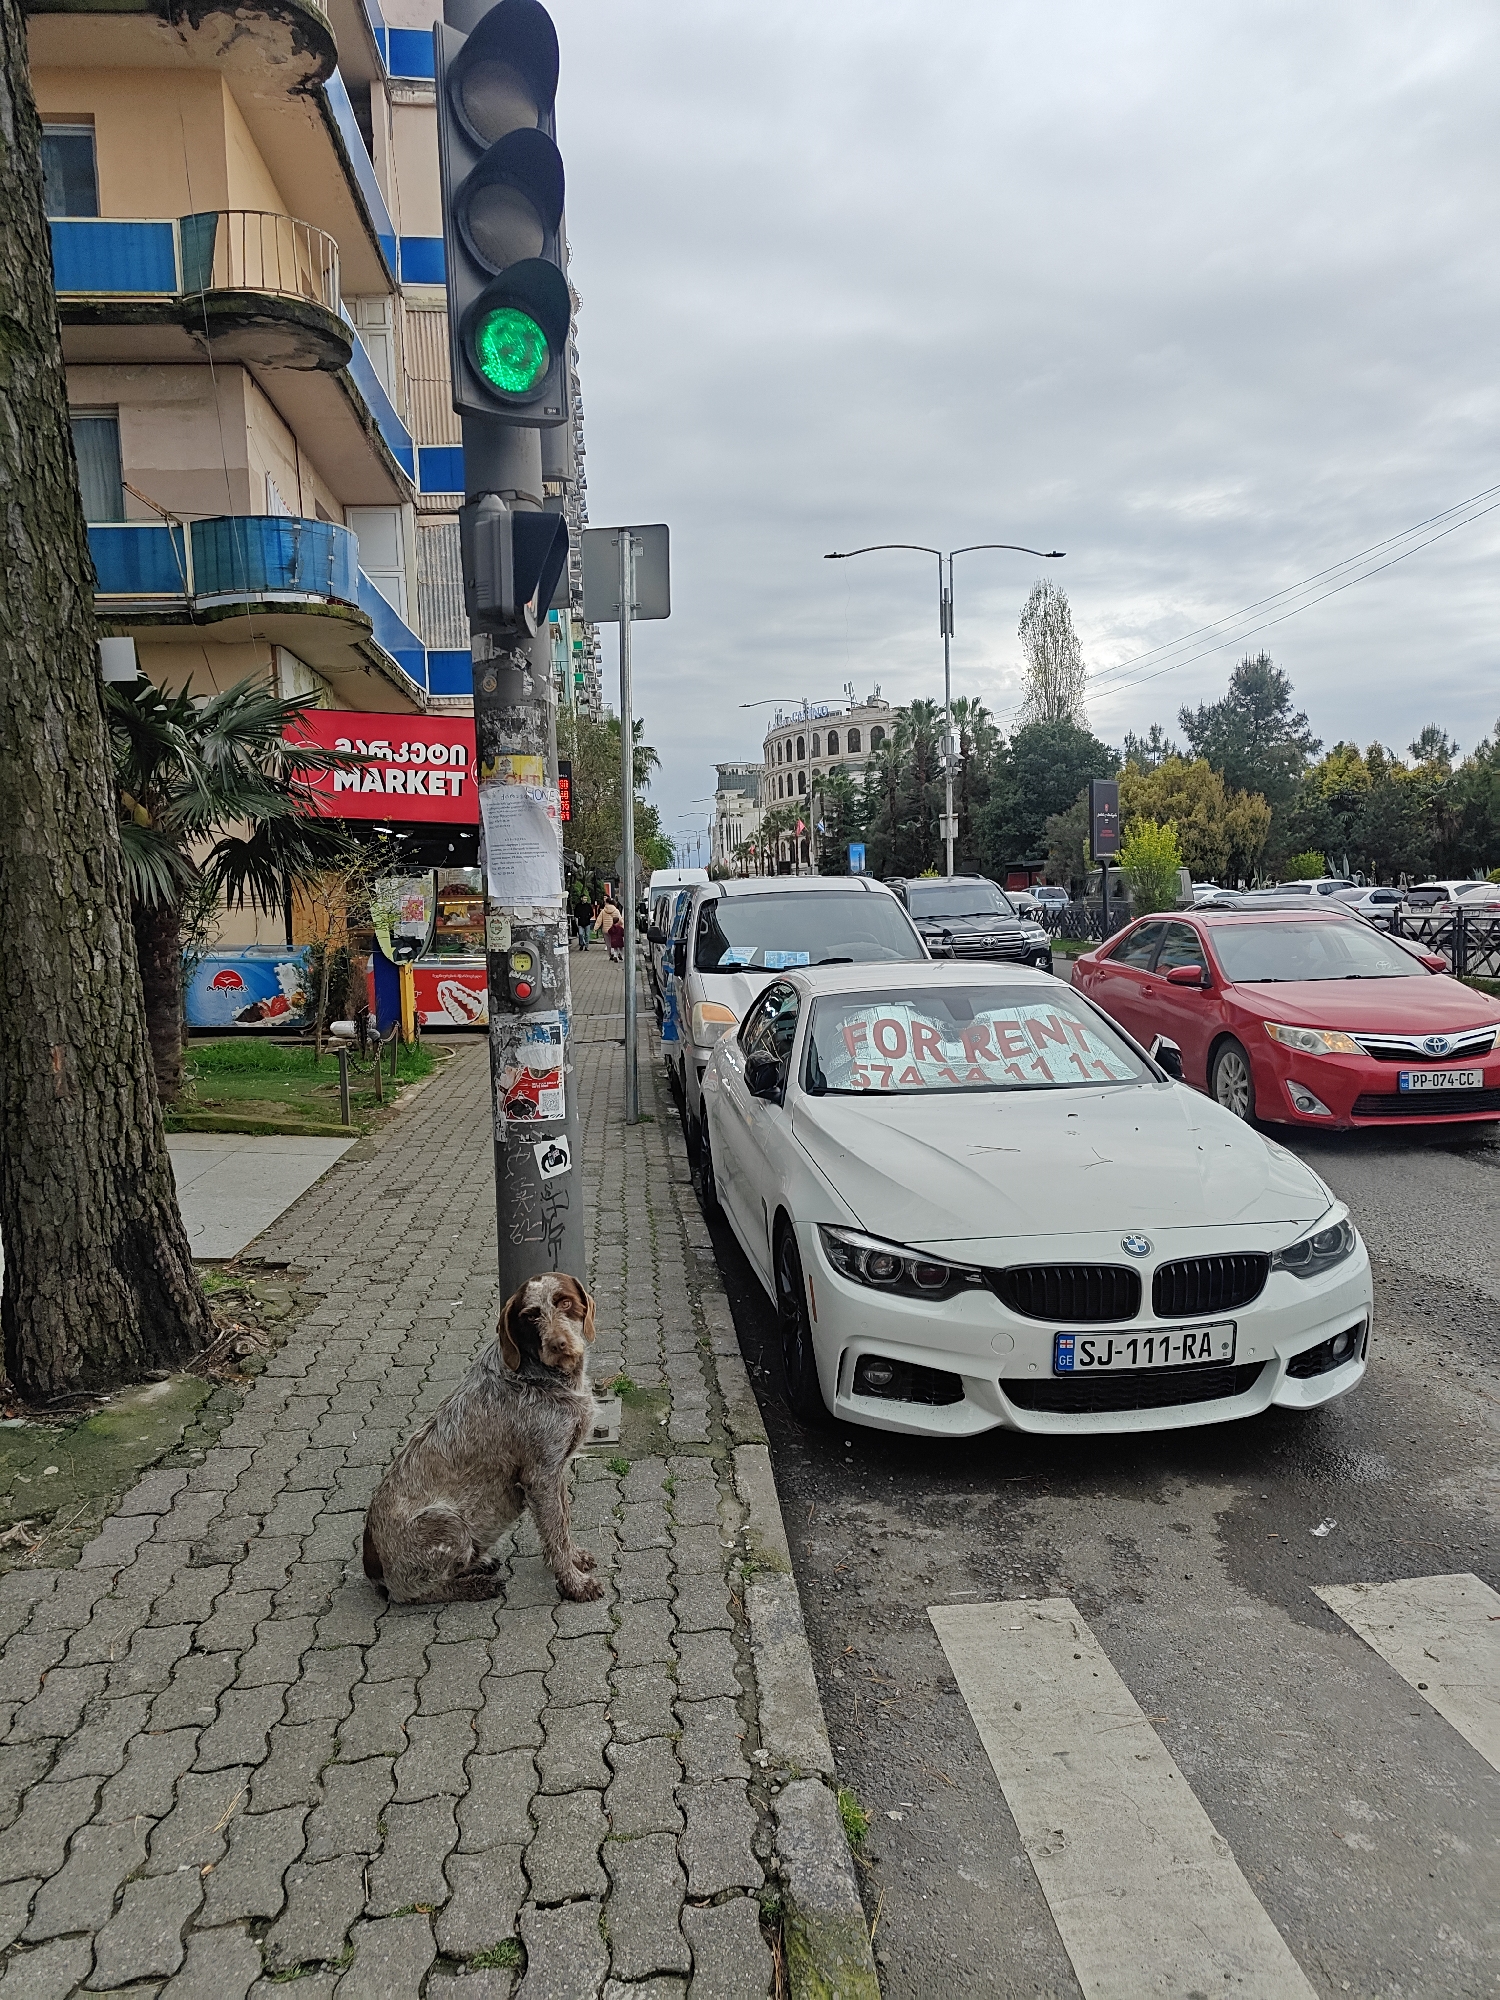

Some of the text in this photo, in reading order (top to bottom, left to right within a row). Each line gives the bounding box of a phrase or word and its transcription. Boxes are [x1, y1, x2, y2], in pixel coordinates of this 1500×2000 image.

[333, 767, 466, 796] MARKET
[843, 1014, 1092, 1063] FOR RENT
[850, 1061, 926, 1088] 574
[1412, 1072, 1475, 1088] PP-074-CC
[1059, 1332, 1212, 1367] GE SJ-111-RA
